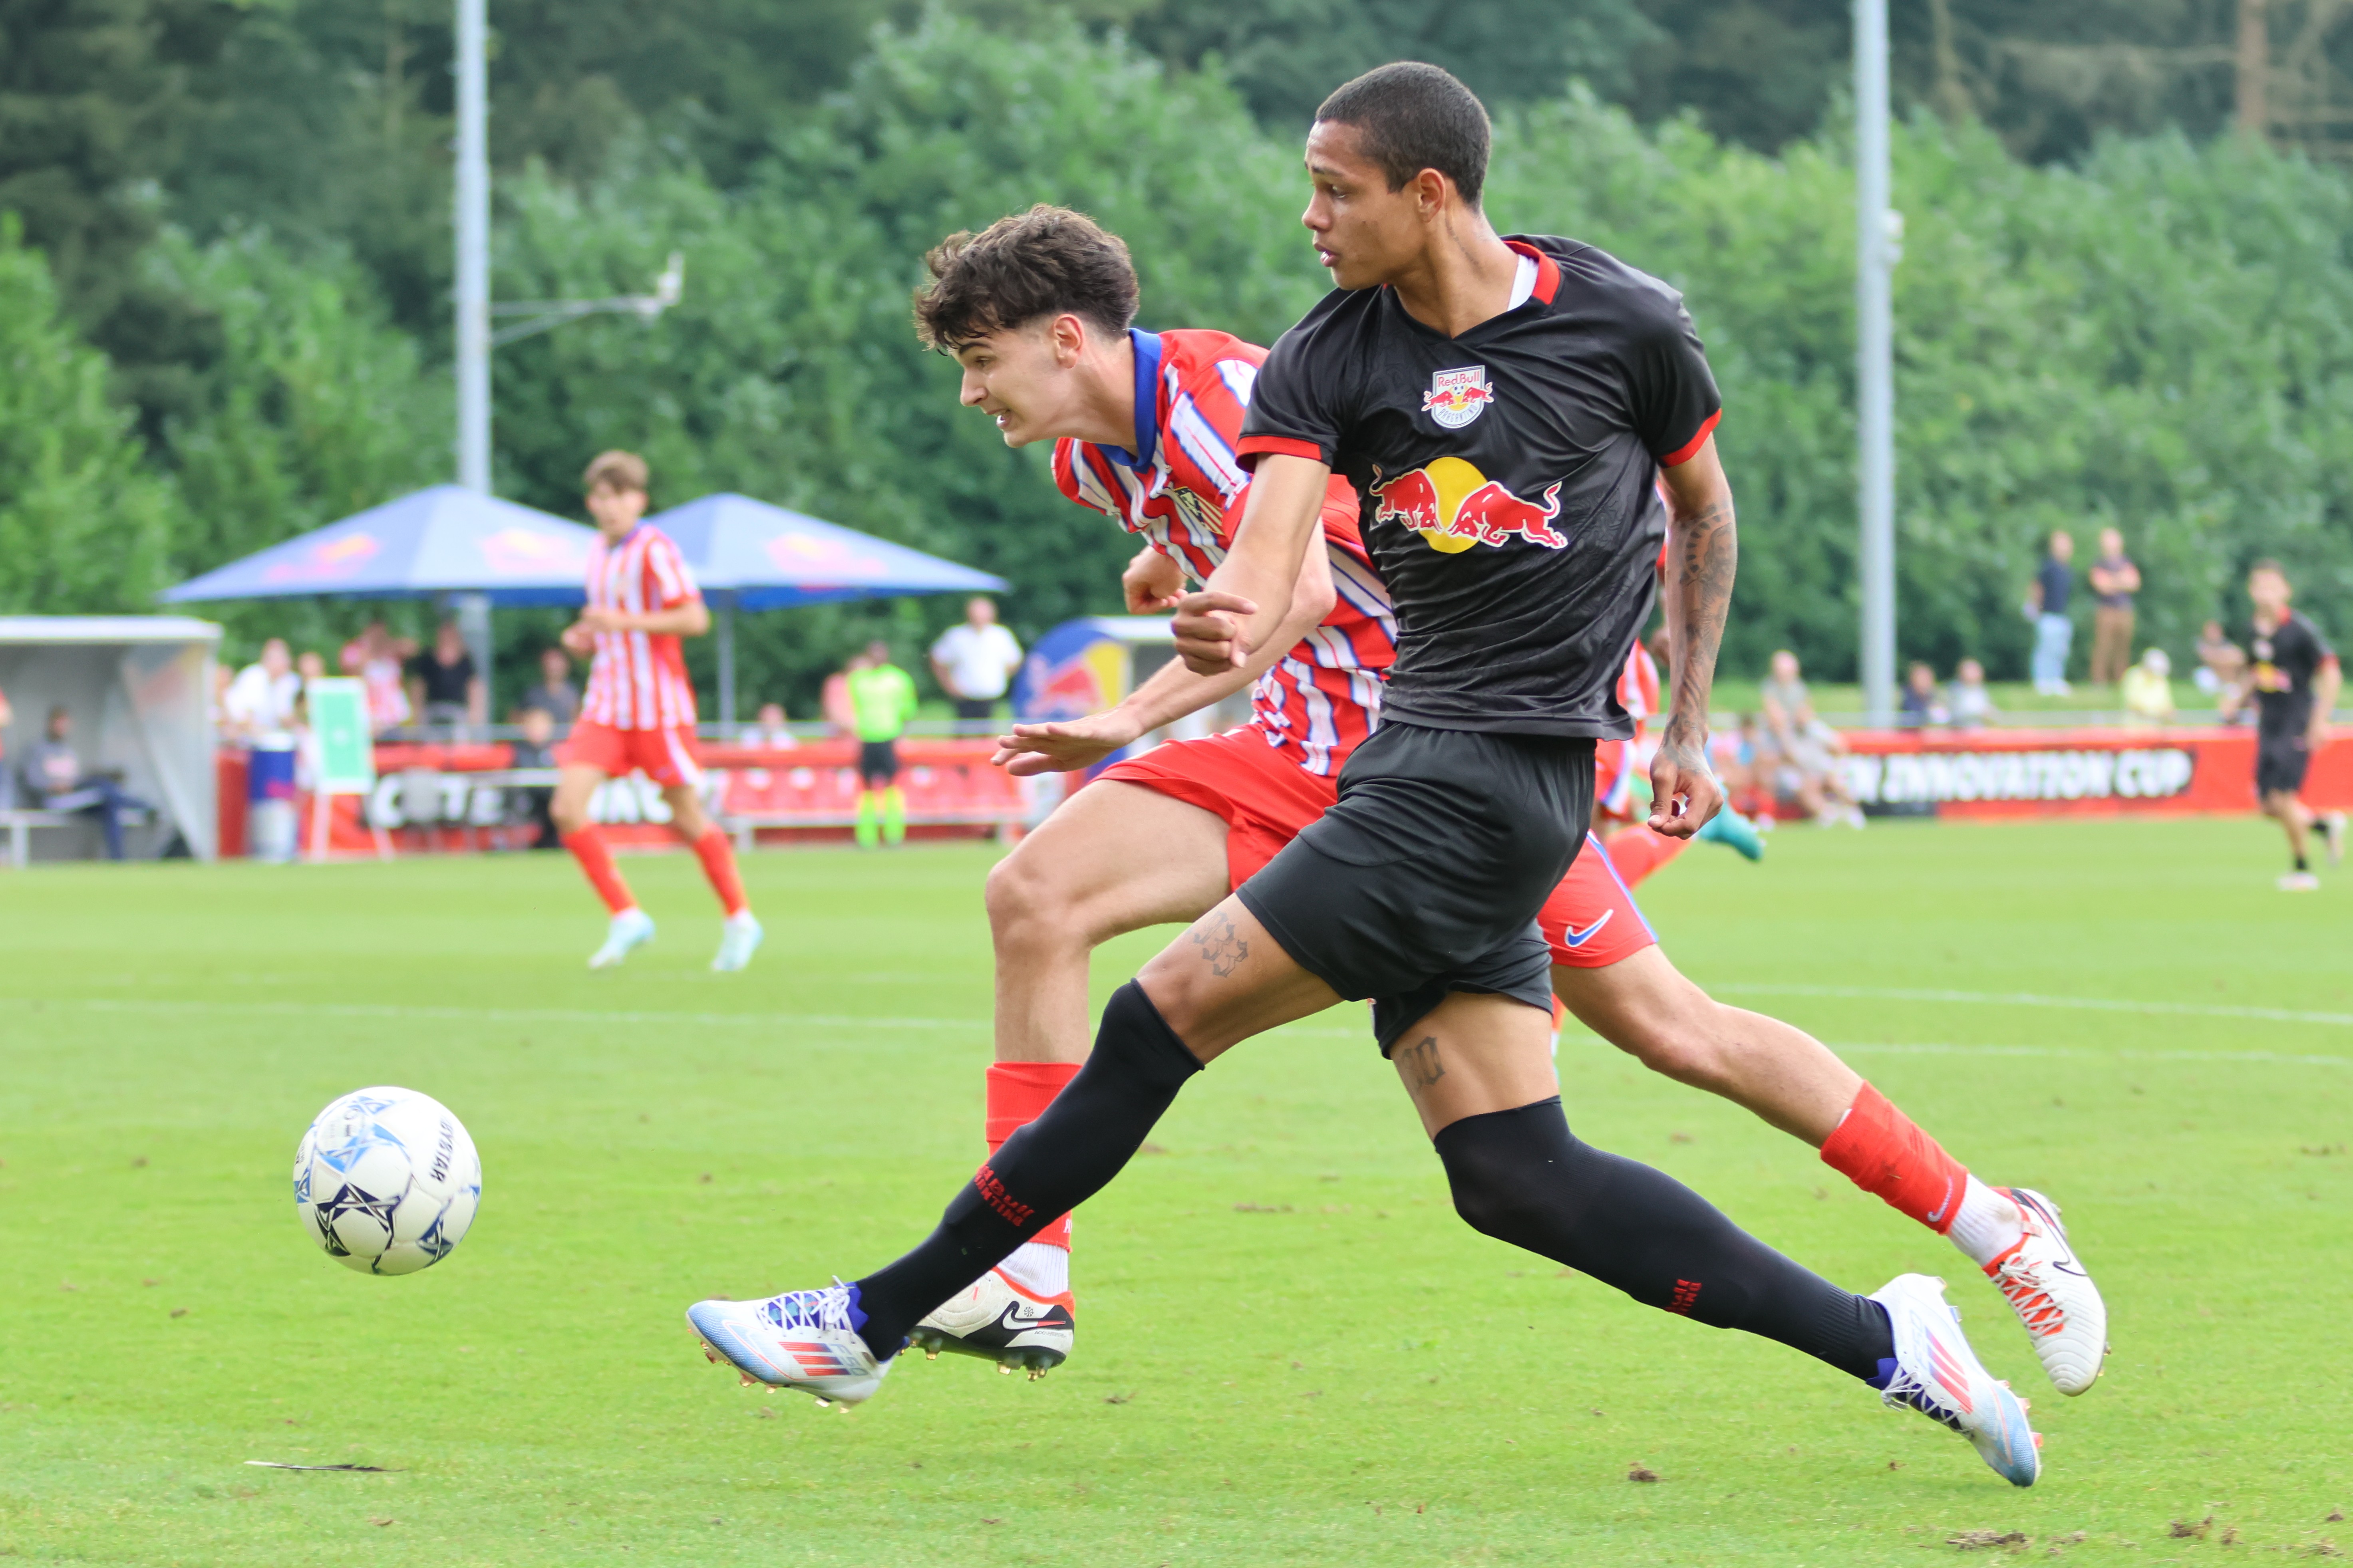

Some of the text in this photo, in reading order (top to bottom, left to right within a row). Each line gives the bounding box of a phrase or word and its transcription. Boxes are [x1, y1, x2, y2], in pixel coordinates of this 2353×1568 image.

[1438, 371, 1480, 387] Red Bull
[1883, 749, 2114, 803] INNOVATION
[2115, 748, 2193, 798] CUP
[429, 1117, 453, 1183] BYSTAR
[829, 1344, 868, 1376] F50
